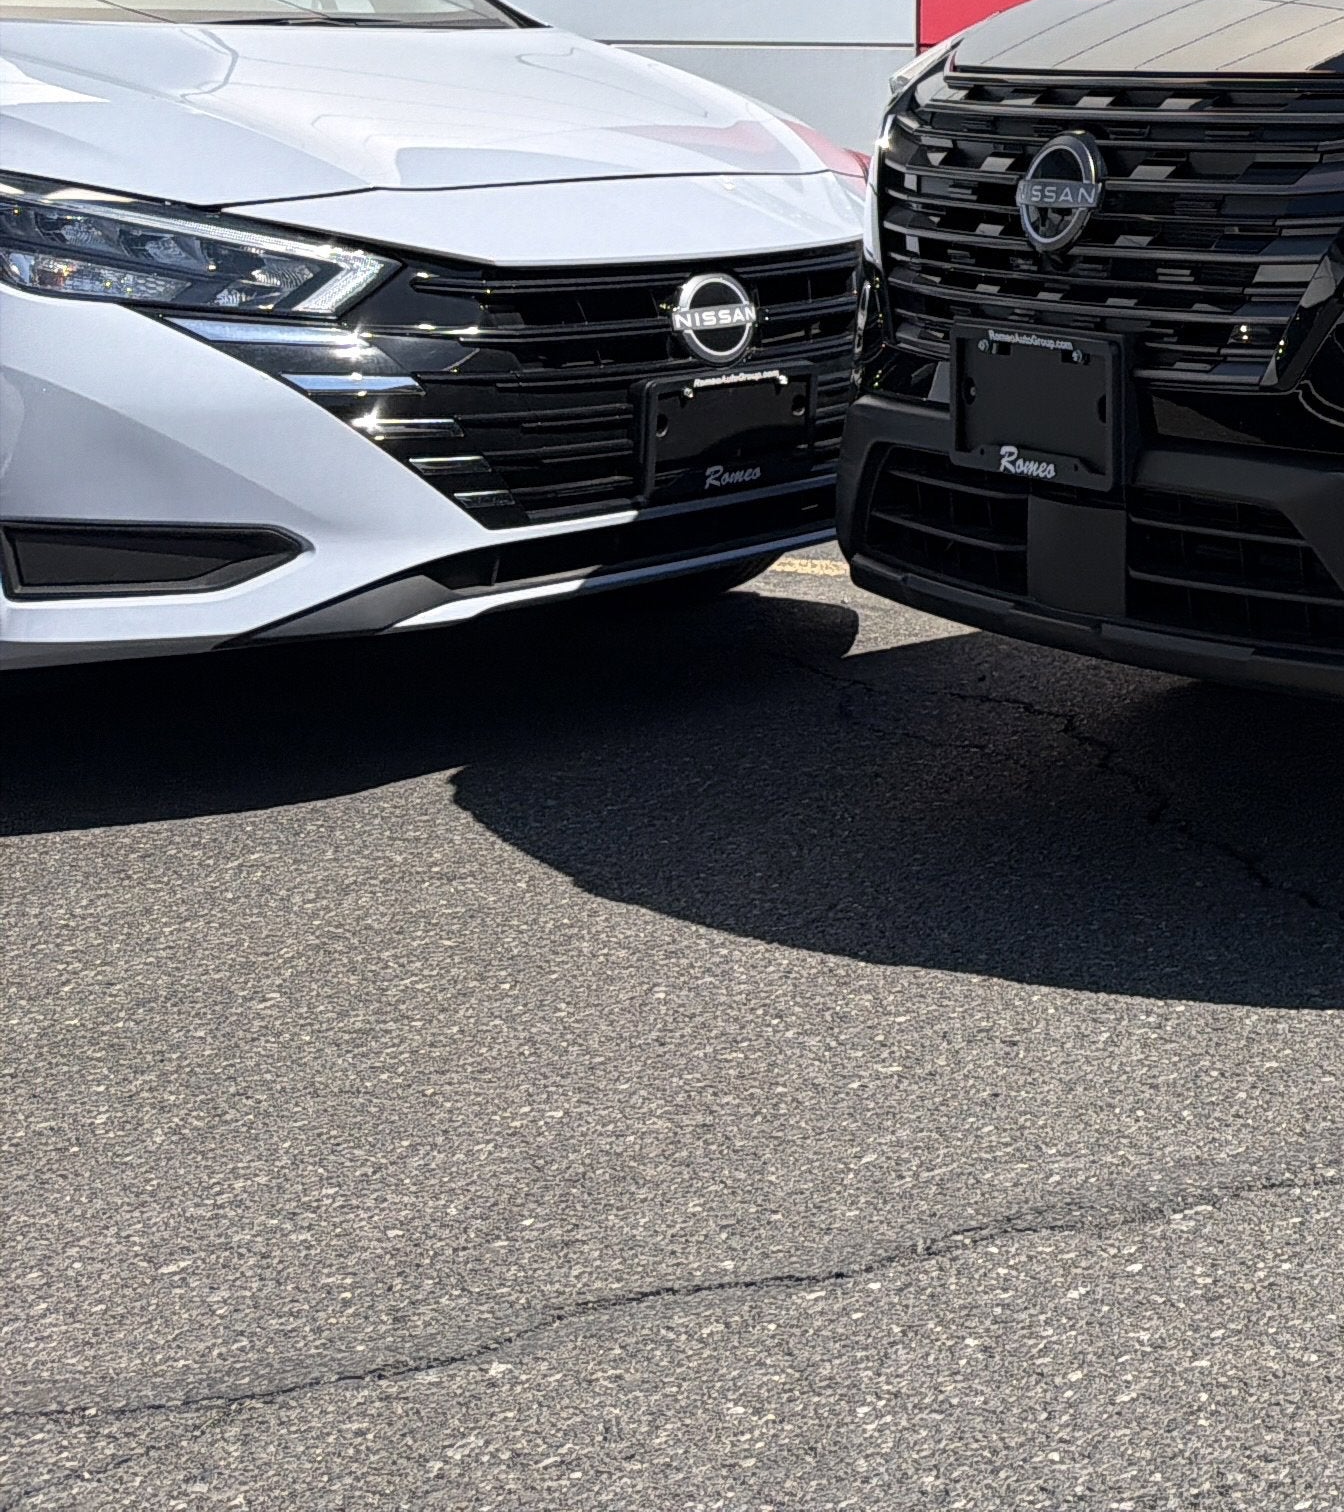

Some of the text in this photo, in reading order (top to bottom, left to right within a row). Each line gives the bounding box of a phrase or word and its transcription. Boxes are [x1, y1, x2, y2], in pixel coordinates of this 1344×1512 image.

[1021, 184, 1096, 204] ISSAN
[674, 306, 757, 329] NISSAN
[988, 329, 1074, 350] RomeoAutoGroup.com
[1000, 445, 1056, 478] Romeo
[704, 464, 762, 490] Romeo
